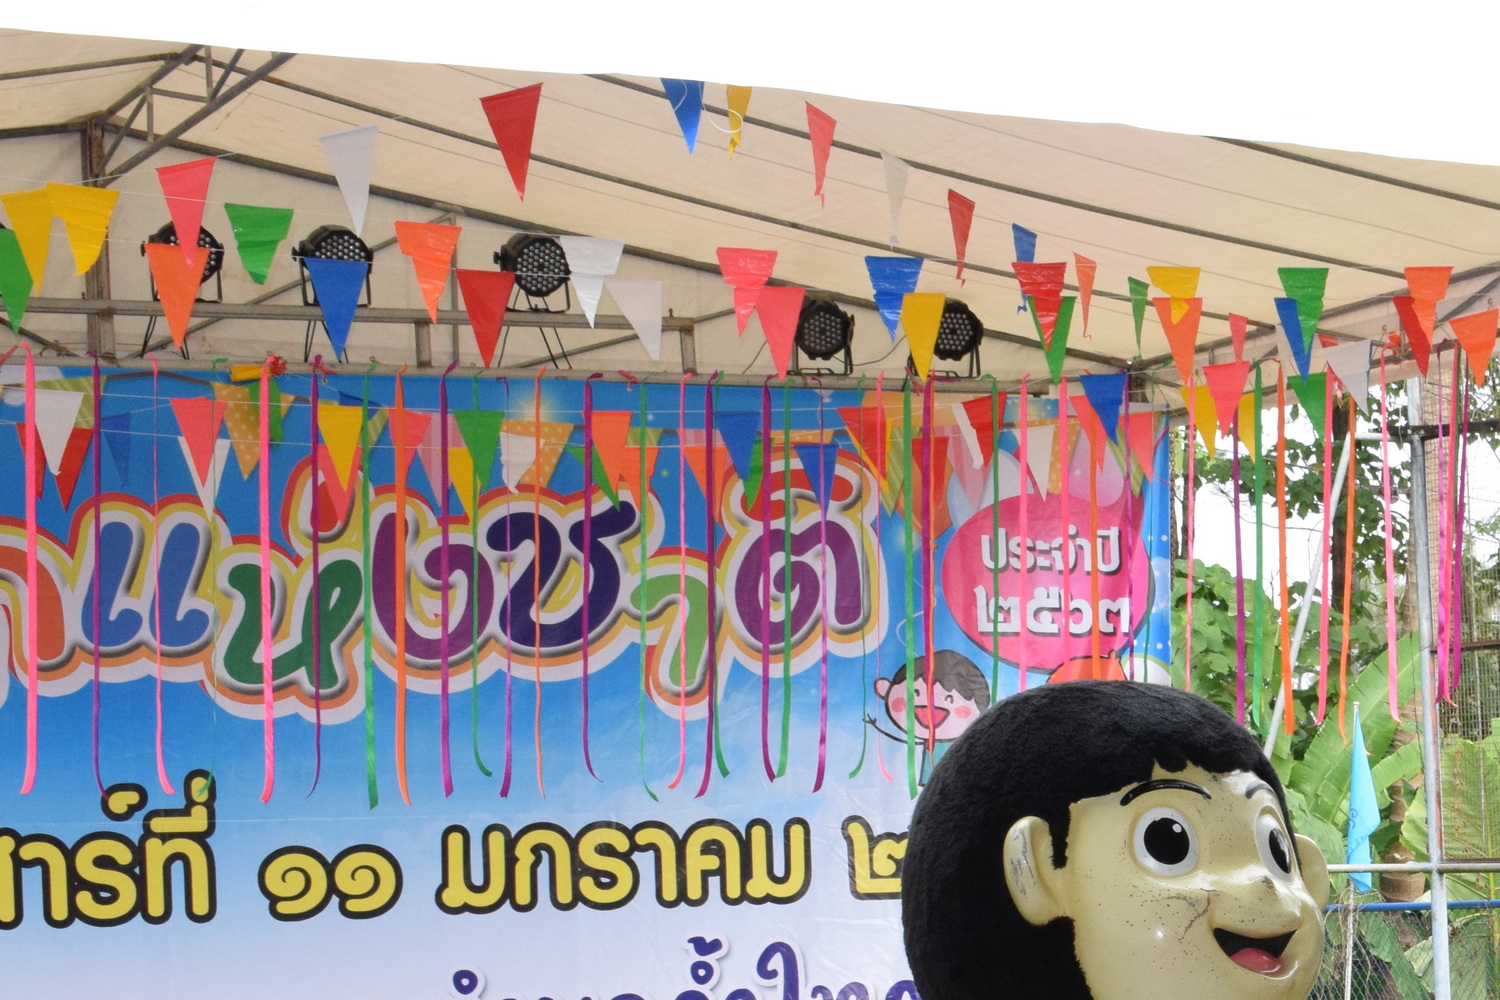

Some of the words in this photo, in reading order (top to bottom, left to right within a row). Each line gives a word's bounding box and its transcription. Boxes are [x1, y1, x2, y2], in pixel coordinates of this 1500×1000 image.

[980, 524, 1121, 574] ประจำปี
[973, 584, 1131, 635] ๒๕๖๓
[258, 844, 403, 919] ๑๑
[436, 817, 811, 914] มกราคม
[842, 815, 909, 900] ๒
